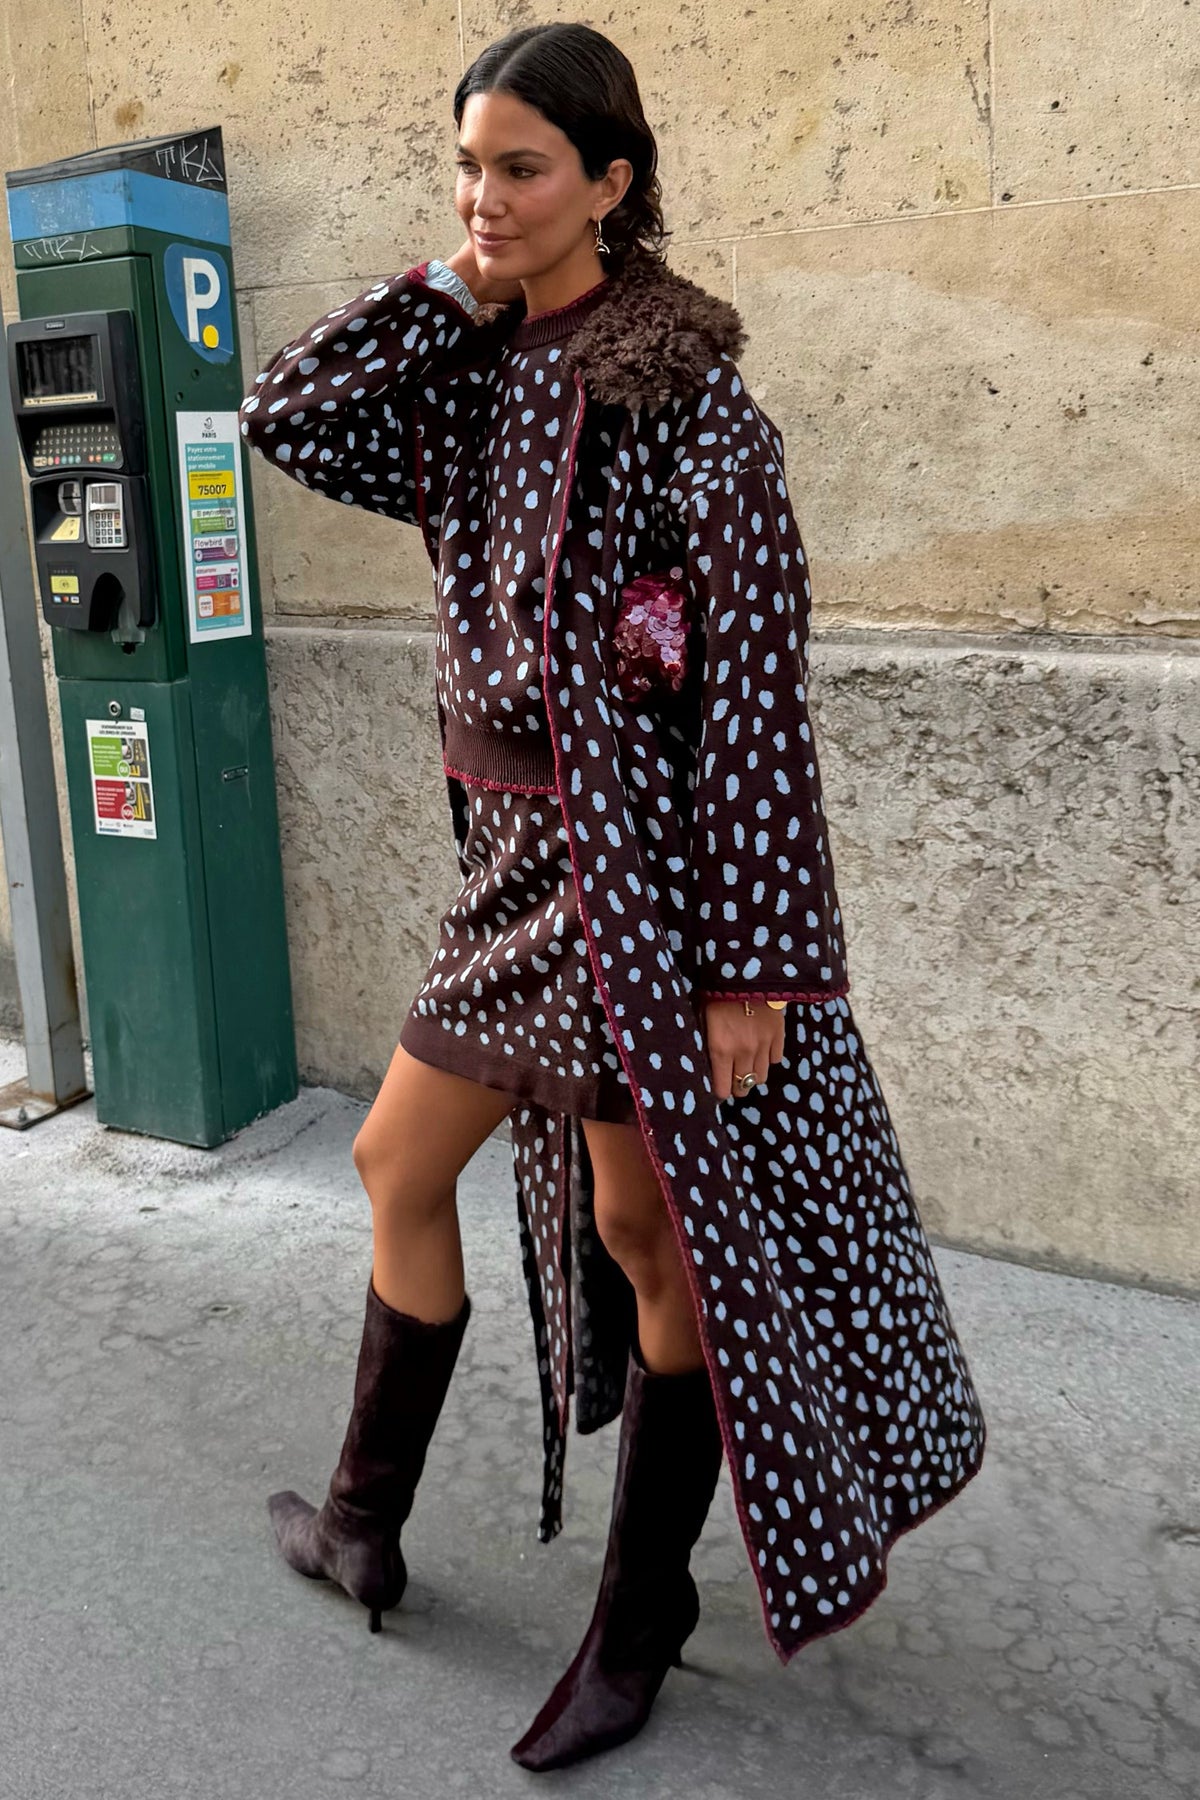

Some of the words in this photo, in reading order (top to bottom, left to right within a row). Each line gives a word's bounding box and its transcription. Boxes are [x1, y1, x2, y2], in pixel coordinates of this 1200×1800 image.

[182, 257, 221, 343] P
[187, 446, 203, 455] Payez
[187, 454, 226, 462] stationnement
[198, 484, 227, 496] 75007
